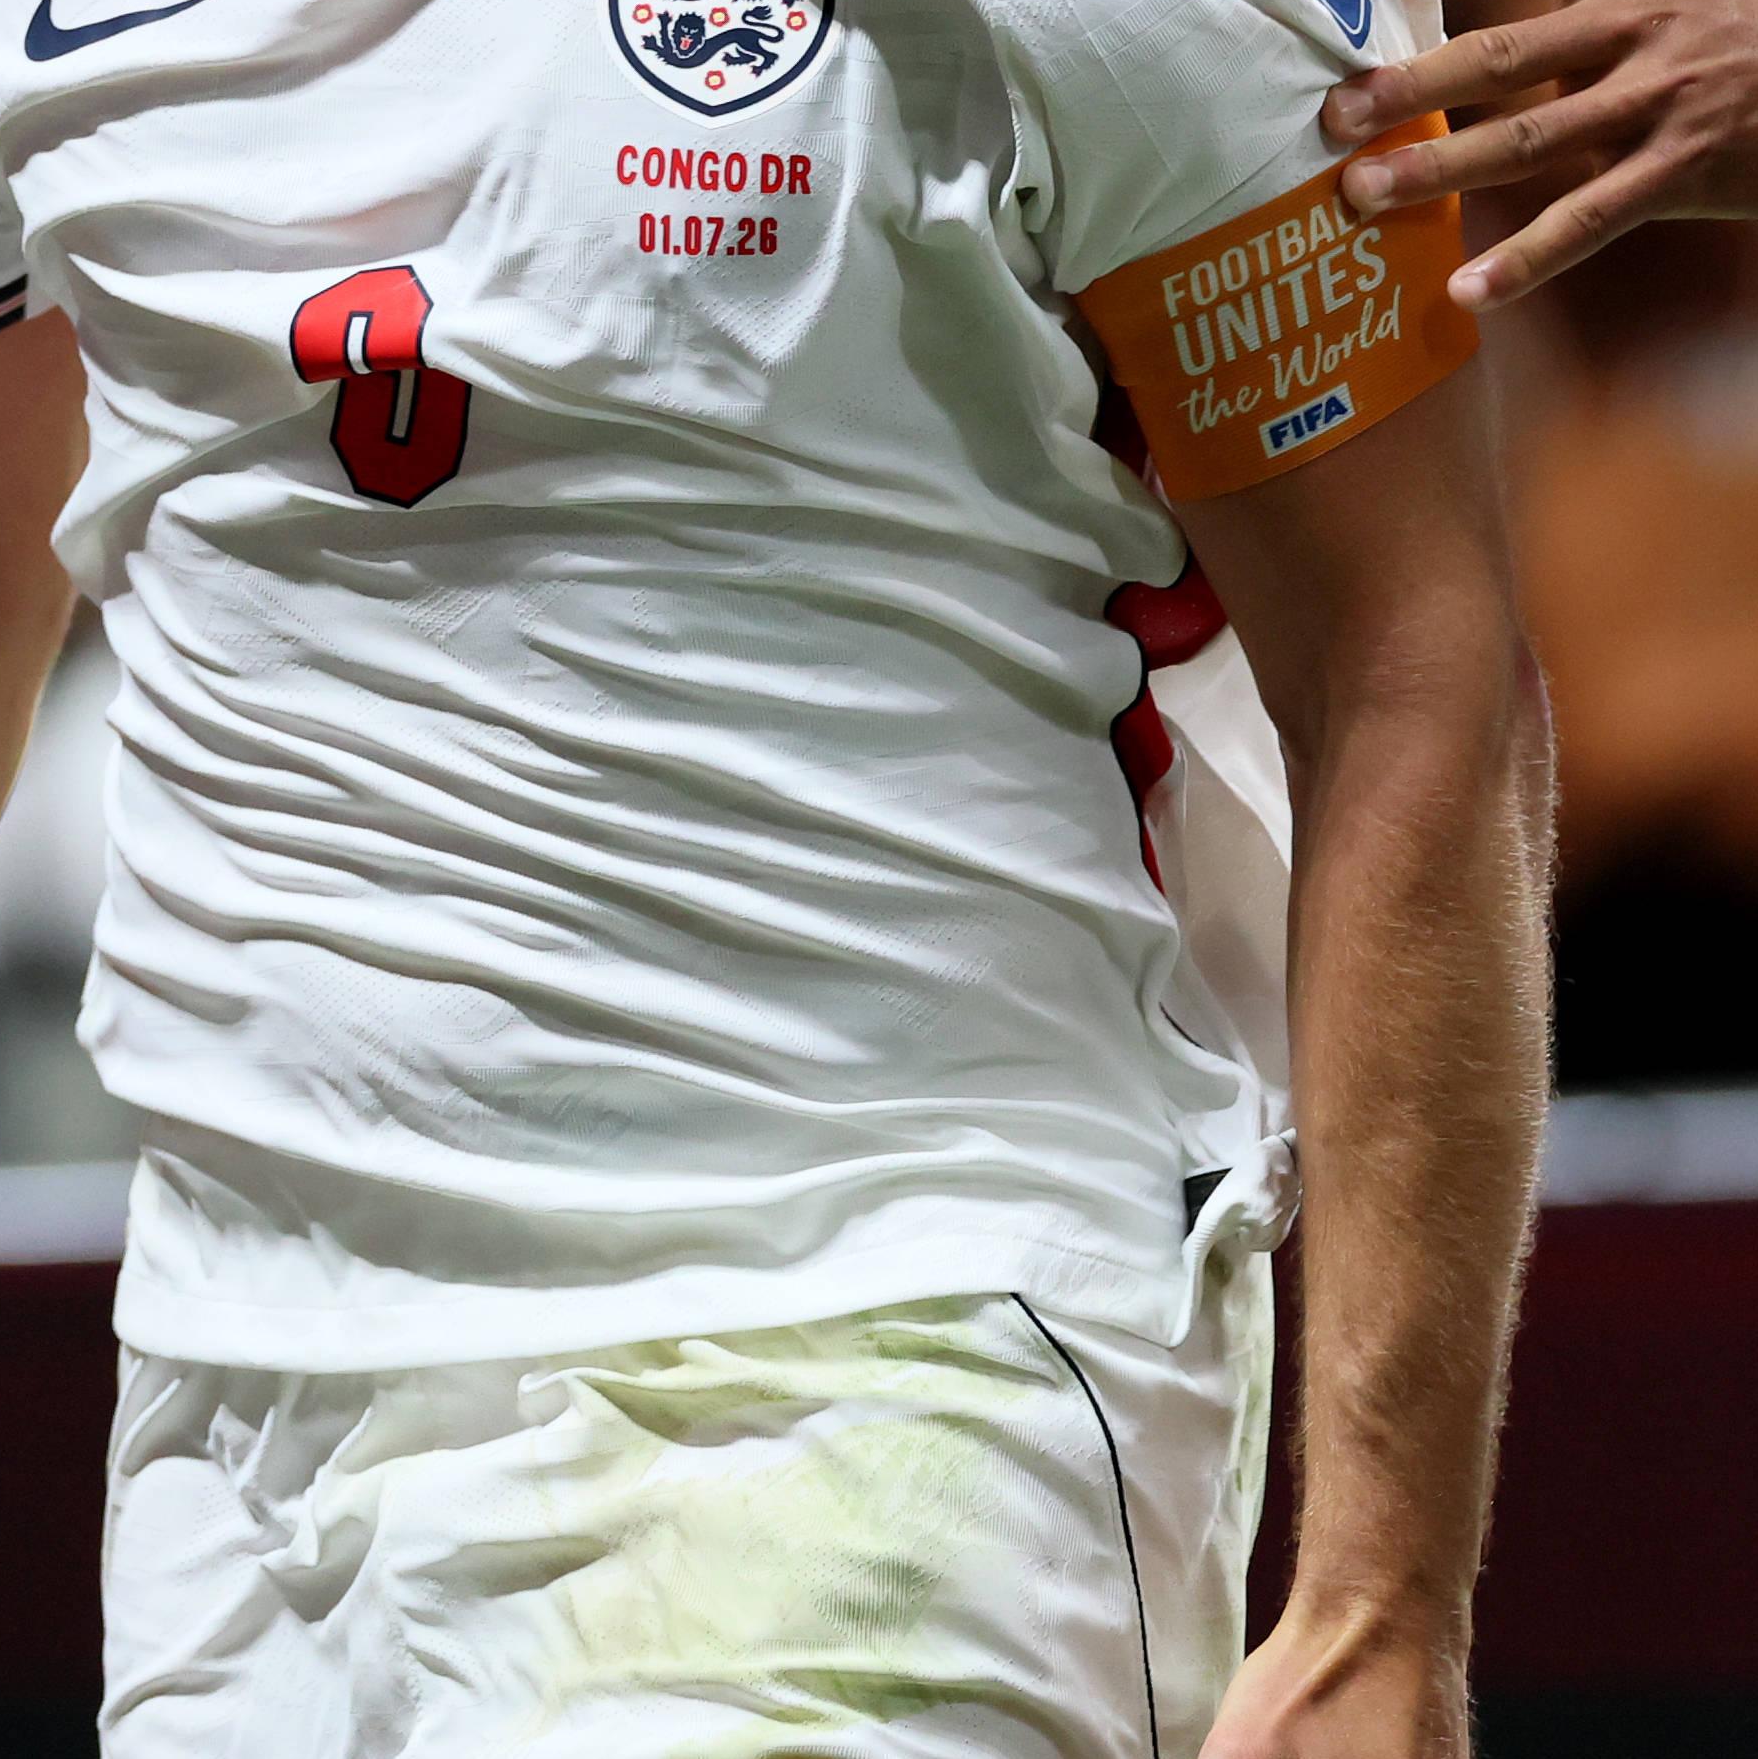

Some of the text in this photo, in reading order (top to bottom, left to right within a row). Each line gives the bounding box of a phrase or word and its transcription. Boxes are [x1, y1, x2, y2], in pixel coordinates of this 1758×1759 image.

[616, 145, 812, 194] CONGO DR
[639, 213, 778, 256] 01.07.26
[1161, 193, 1358, 319] FOOTBAL
[1172, 227, 1387, 376] UNITES
[1177, 284, 1402, 434] the World
[1268, 395, 1348, 449] FIFA
